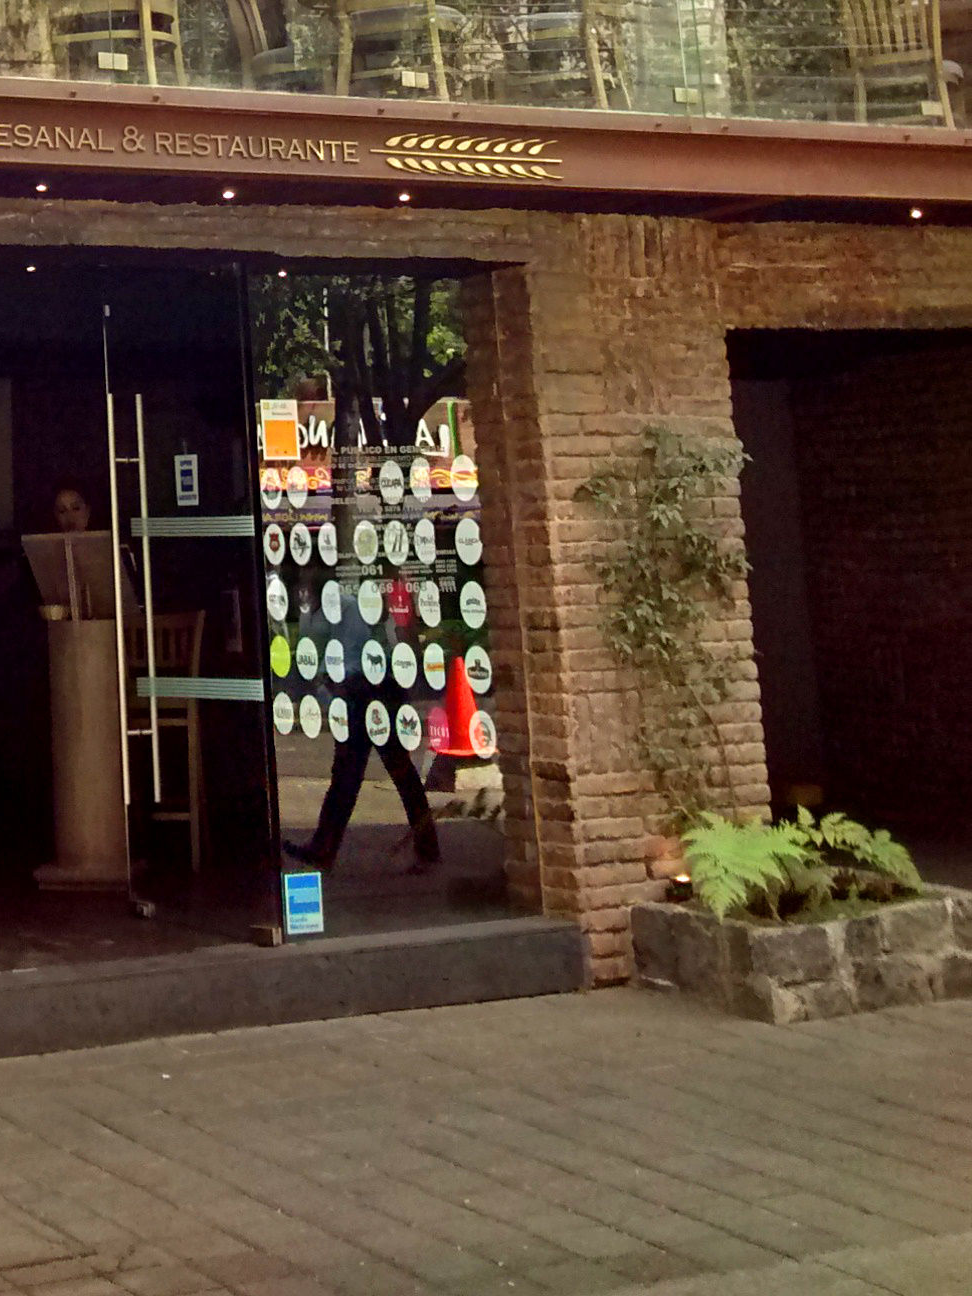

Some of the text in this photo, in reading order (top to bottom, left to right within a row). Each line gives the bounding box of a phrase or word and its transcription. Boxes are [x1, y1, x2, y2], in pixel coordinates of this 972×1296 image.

[122, 125, 146, 153] &
[155, 131, 360, 163] RESTAURANTE
[384, 445, 398, 454] EN
